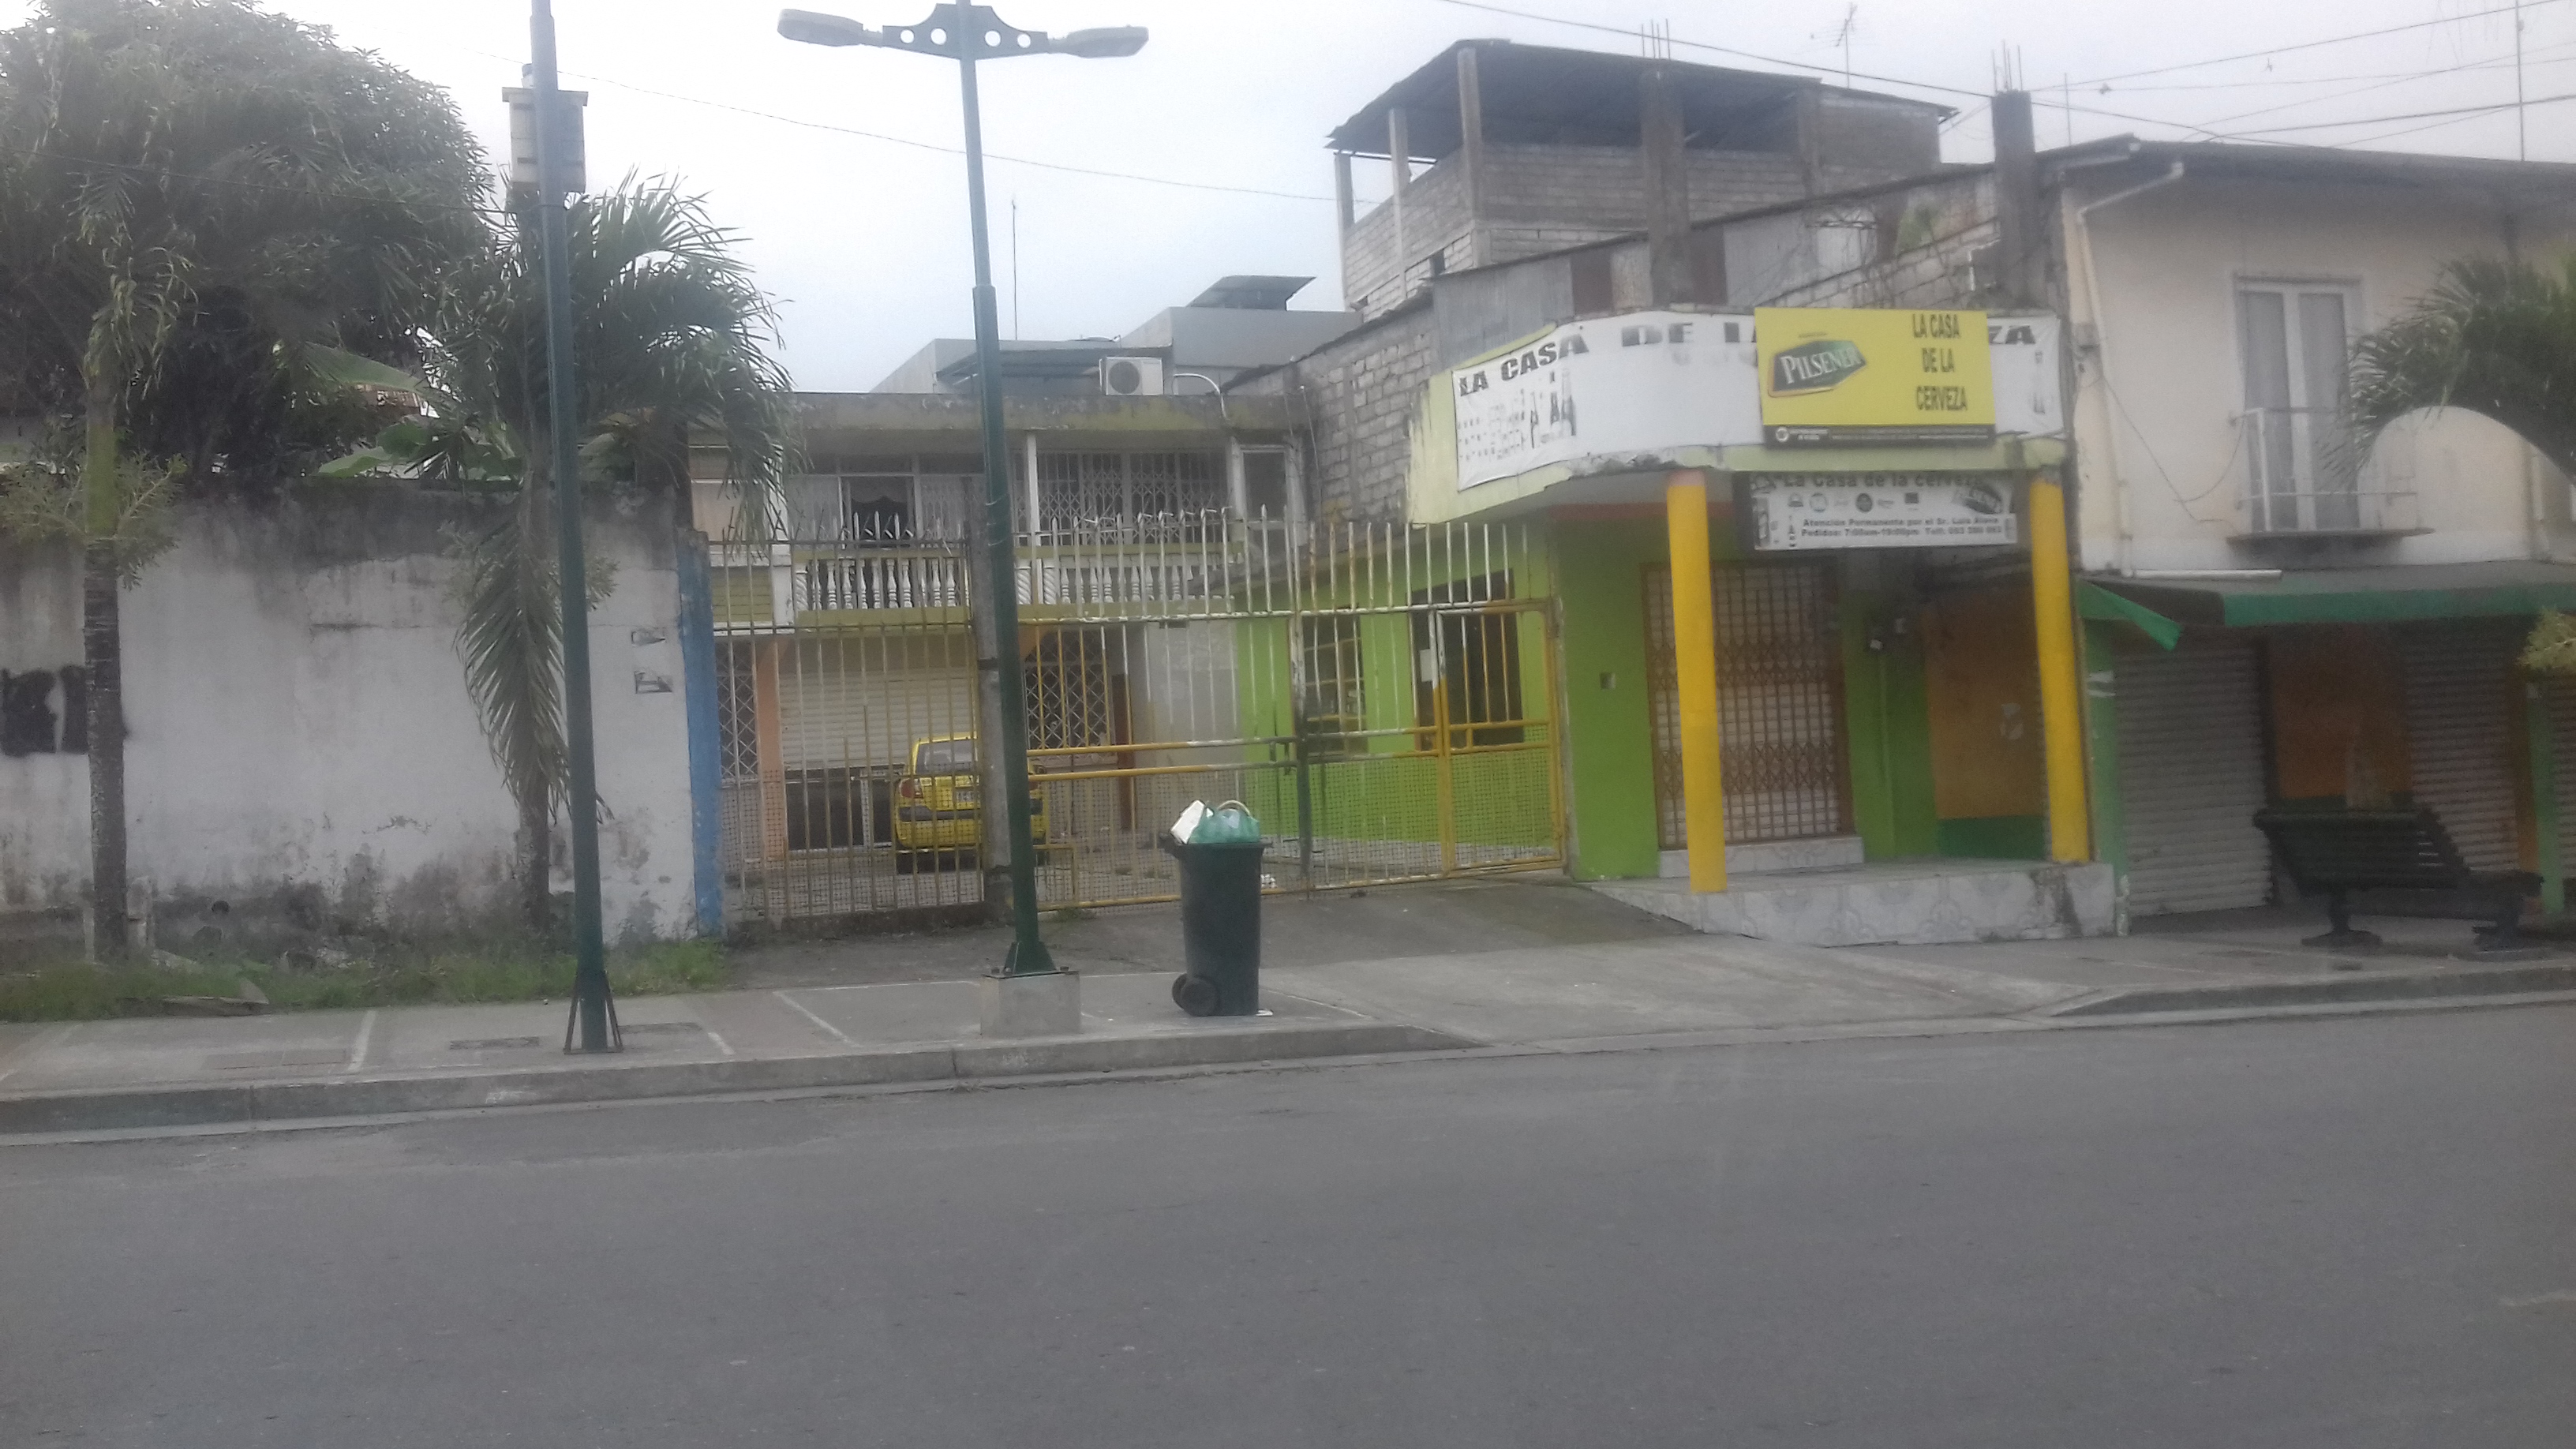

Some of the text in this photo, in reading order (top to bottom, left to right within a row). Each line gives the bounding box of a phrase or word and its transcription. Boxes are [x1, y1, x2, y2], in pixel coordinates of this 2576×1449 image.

[1913, 314, 1960, 338] LA CASA
[1459, 370, 1489, 396] LA
[1500, 333, 1589, 381] CASA
[1780, 347, 1863, 384] PILSENER
[1922, 347, 1955, 372] DE LA
[1916, 385, 1968, 410] CERVEZA
